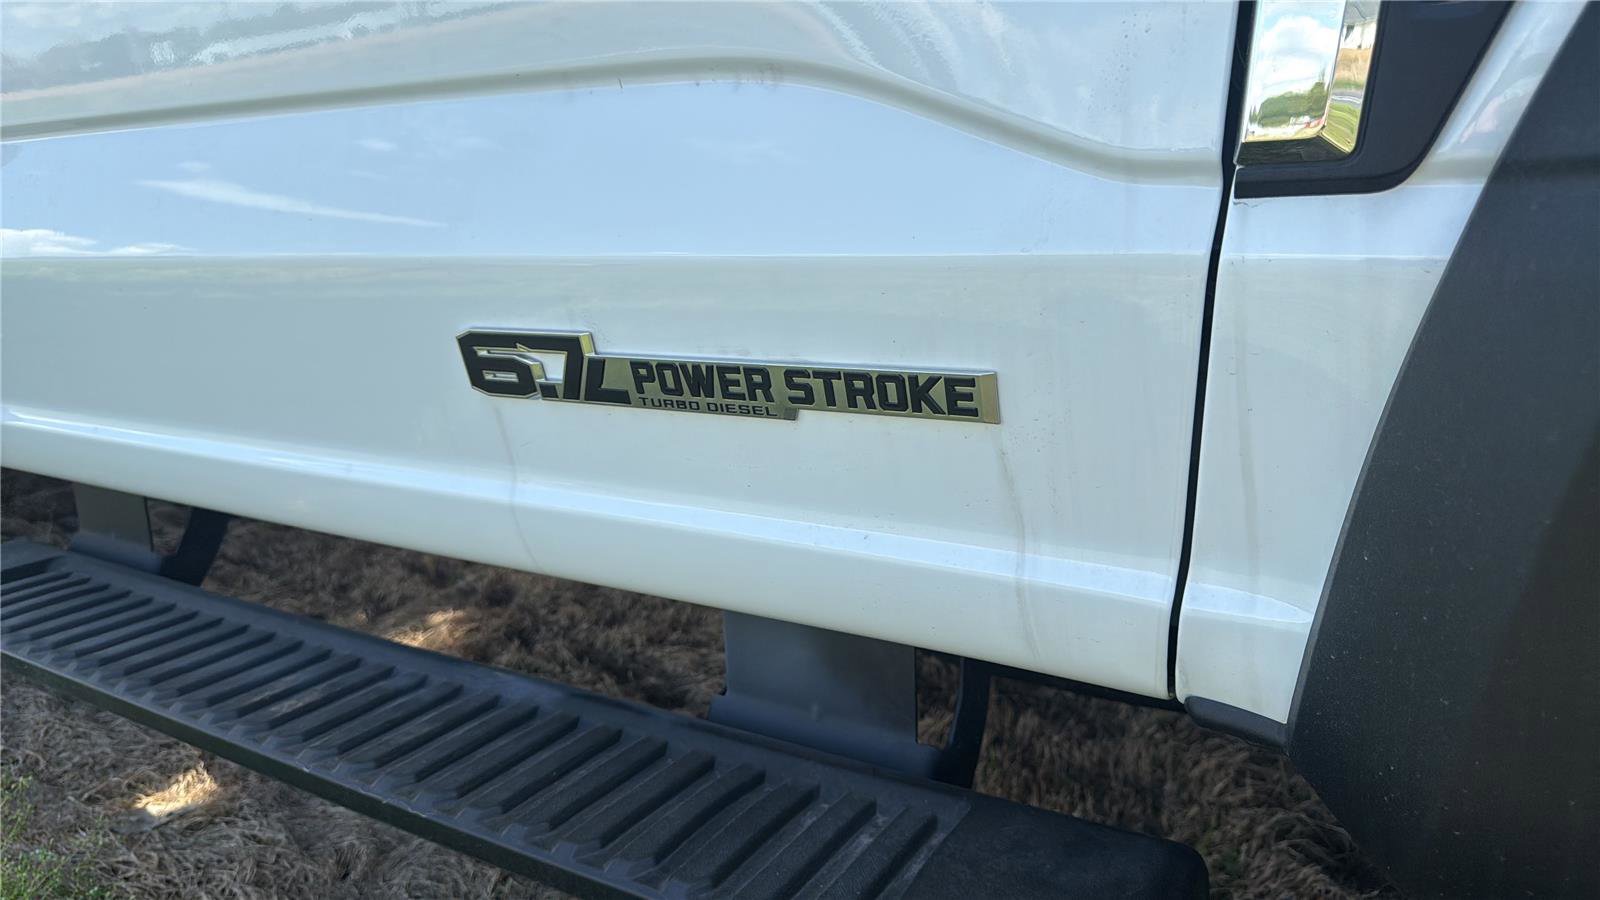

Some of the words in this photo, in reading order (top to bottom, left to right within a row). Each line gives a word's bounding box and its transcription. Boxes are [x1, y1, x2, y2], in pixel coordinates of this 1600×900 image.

[456, 329, 632, 405] 6.7L
[629, 360, 775, 402] POWER
[783, 368, 979, 418] STROKE
[638, 397, 700, 411] TURBO
[706, 400, 778, 417] DIESEL
